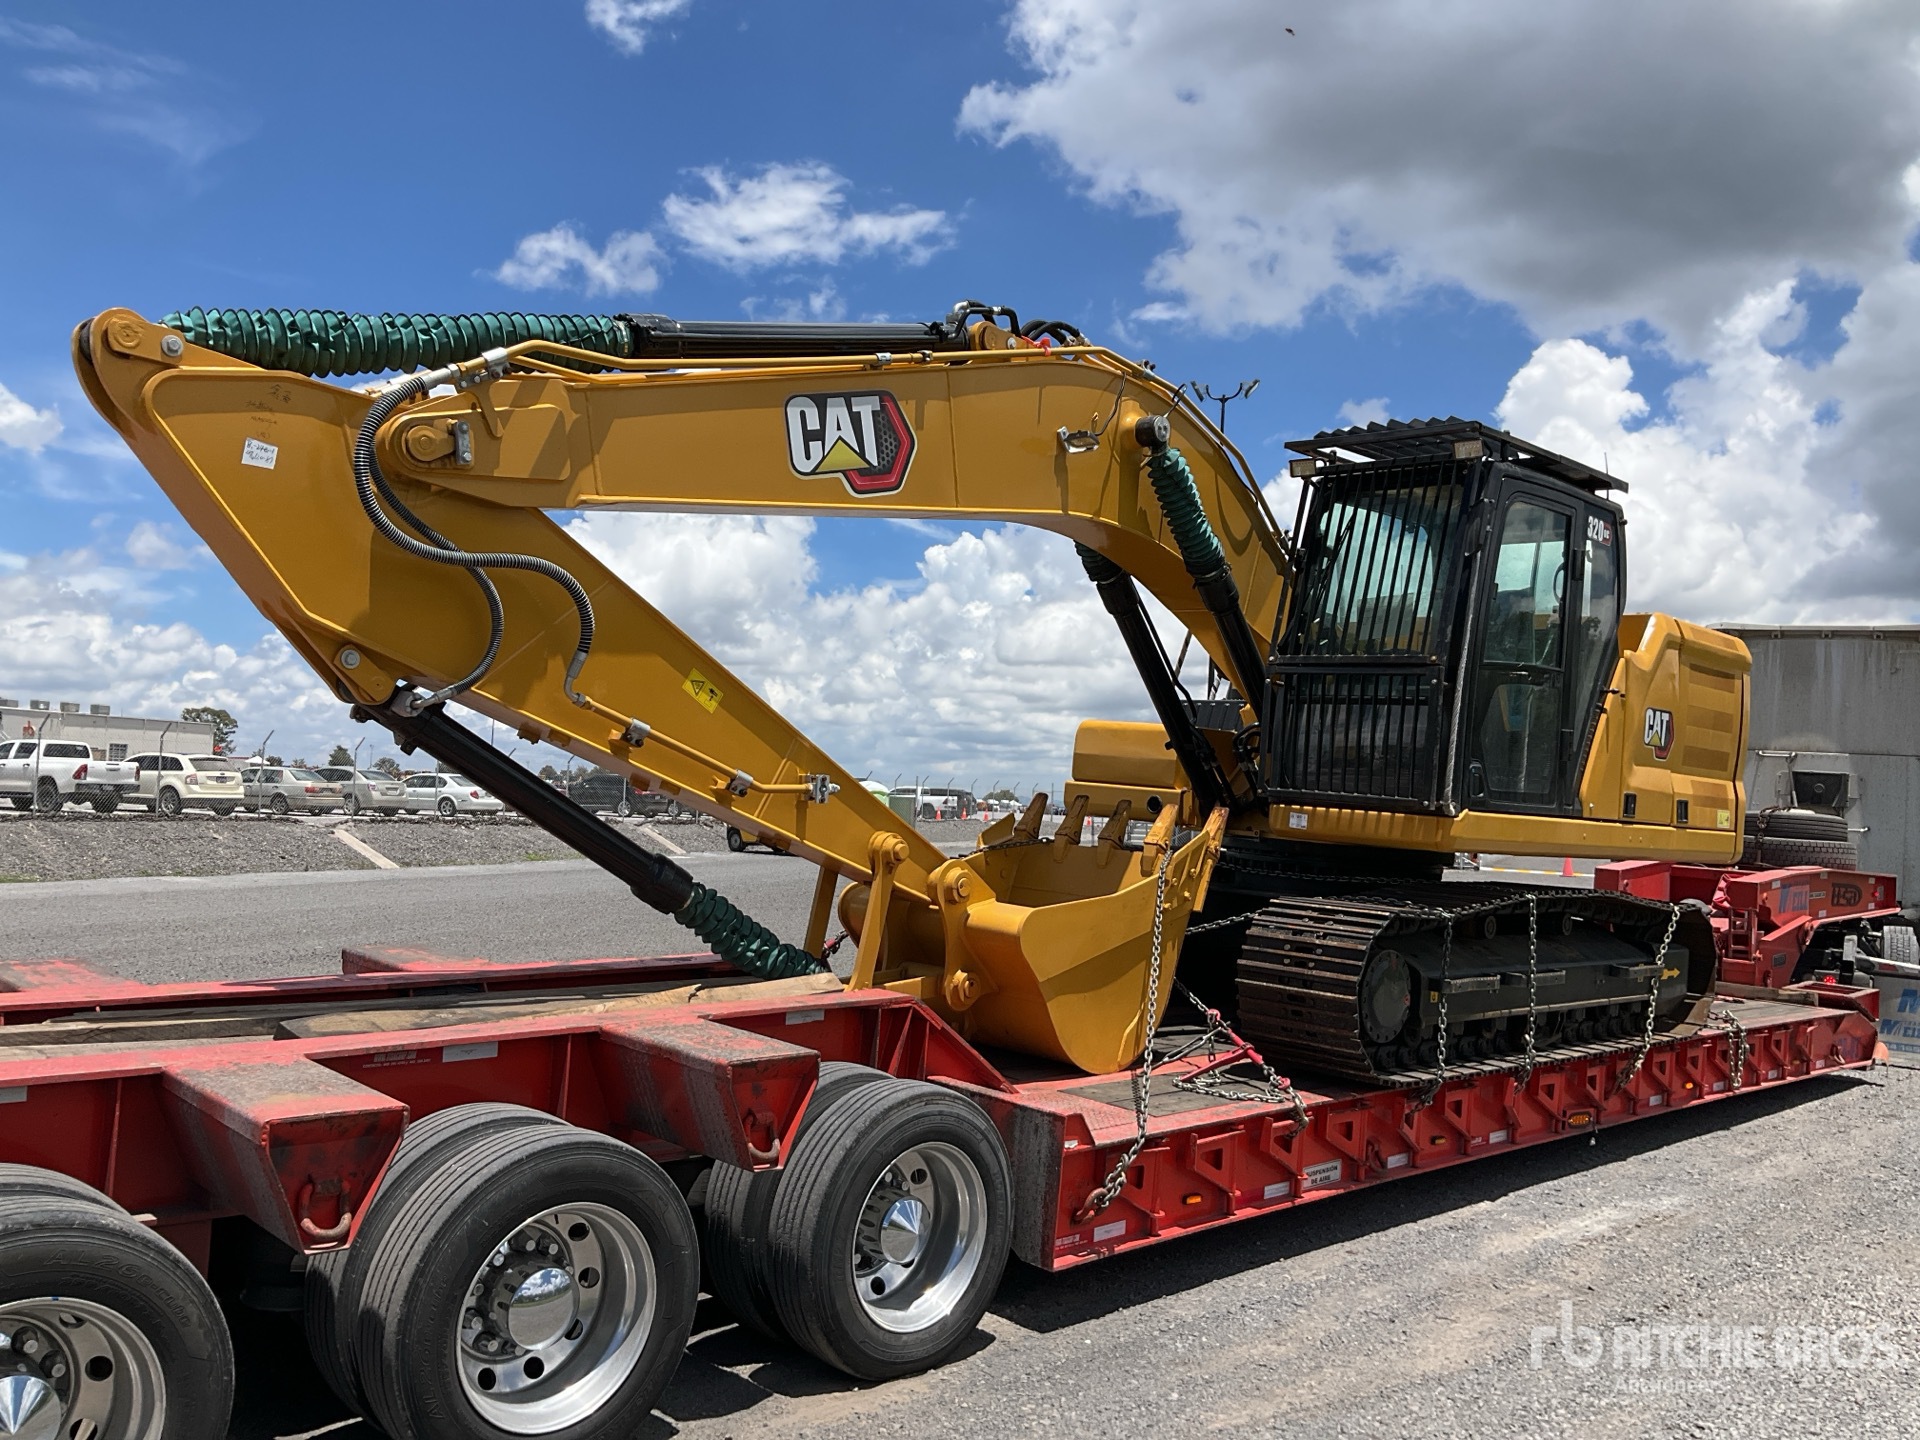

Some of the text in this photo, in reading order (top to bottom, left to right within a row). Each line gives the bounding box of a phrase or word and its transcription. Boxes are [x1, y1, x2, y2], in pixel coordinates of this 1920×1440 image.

[787, 396, 880, 473] CAT
[1587, 515, 1604, 542] 320
[1645, 707, 1670, 747] CAT
